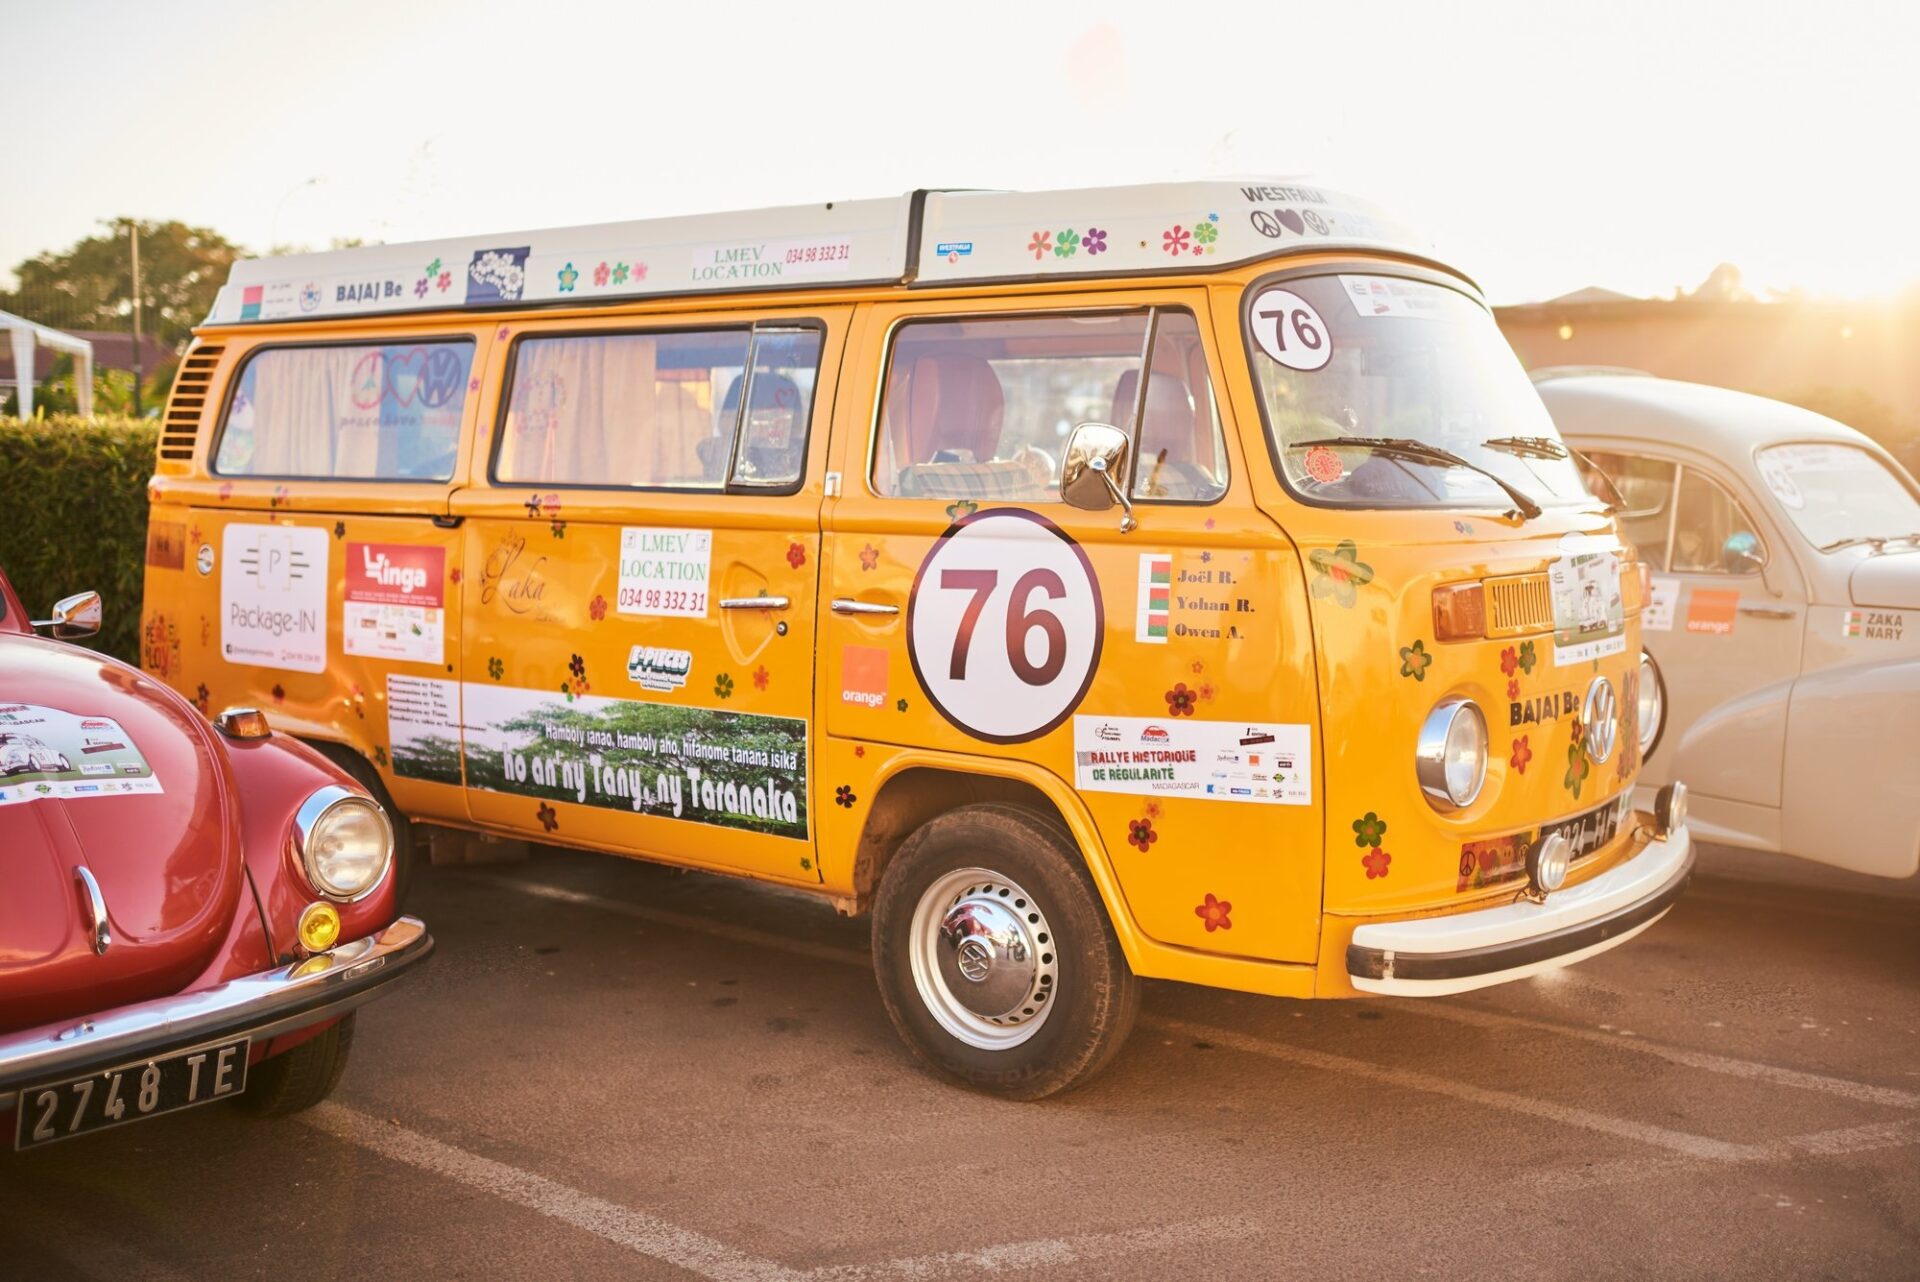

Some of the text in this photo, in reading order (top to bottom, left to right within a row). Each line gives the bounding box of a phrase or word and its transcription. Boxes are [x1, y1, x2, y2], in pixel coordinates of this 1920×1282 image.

[1240, 186, 1328, 204] WESTFALIA
[714, 245, 766, 263] LMEV
[786, 244, 850, 264] 034 98 332 31
[692, 262, 783, 281] LOCATION
[335, 281, 402, 303] BAJAJ Be
[1258, 308, 1322, 352] 76
[642, 533, 688, 553] LMEV
[621, 559, 707, 581] LOCATION
[1177, 570, 1237, 584] Joël R.
[619, 588, 706, 611] 034 98 332 31
[1177, 596, 1255, 612] Yohan R.
[231, 602, 316, 637] Package-IN
[940, 567, 1067, 687] 76
[1687, 621, 1730, 634] orange
[1867, 612, 1903, 627] ZAKA
[1175, 623, 1244, 639] Owen A.
[1866, 626, 1903, 640] NARY
[842, 690, 885, 707] orange
[1510, 691, 1580, 727] BAJAJ Be
[545, 722, 585, 748] Hamboly
[617, 730, 657, 757] hamboly
[1090, 750, 1197, 764] RALLYE HISTORIQUE
[1092, 764, 1175, 781] DE RÉGULARITÉ
[657, 773, 682, 818] ny
[687, 767, 797, 824] Taranaka
[1152, 782, 1200, 790] MADAGASCAR
[32, 1046, 237, 1141] 2748 TE
